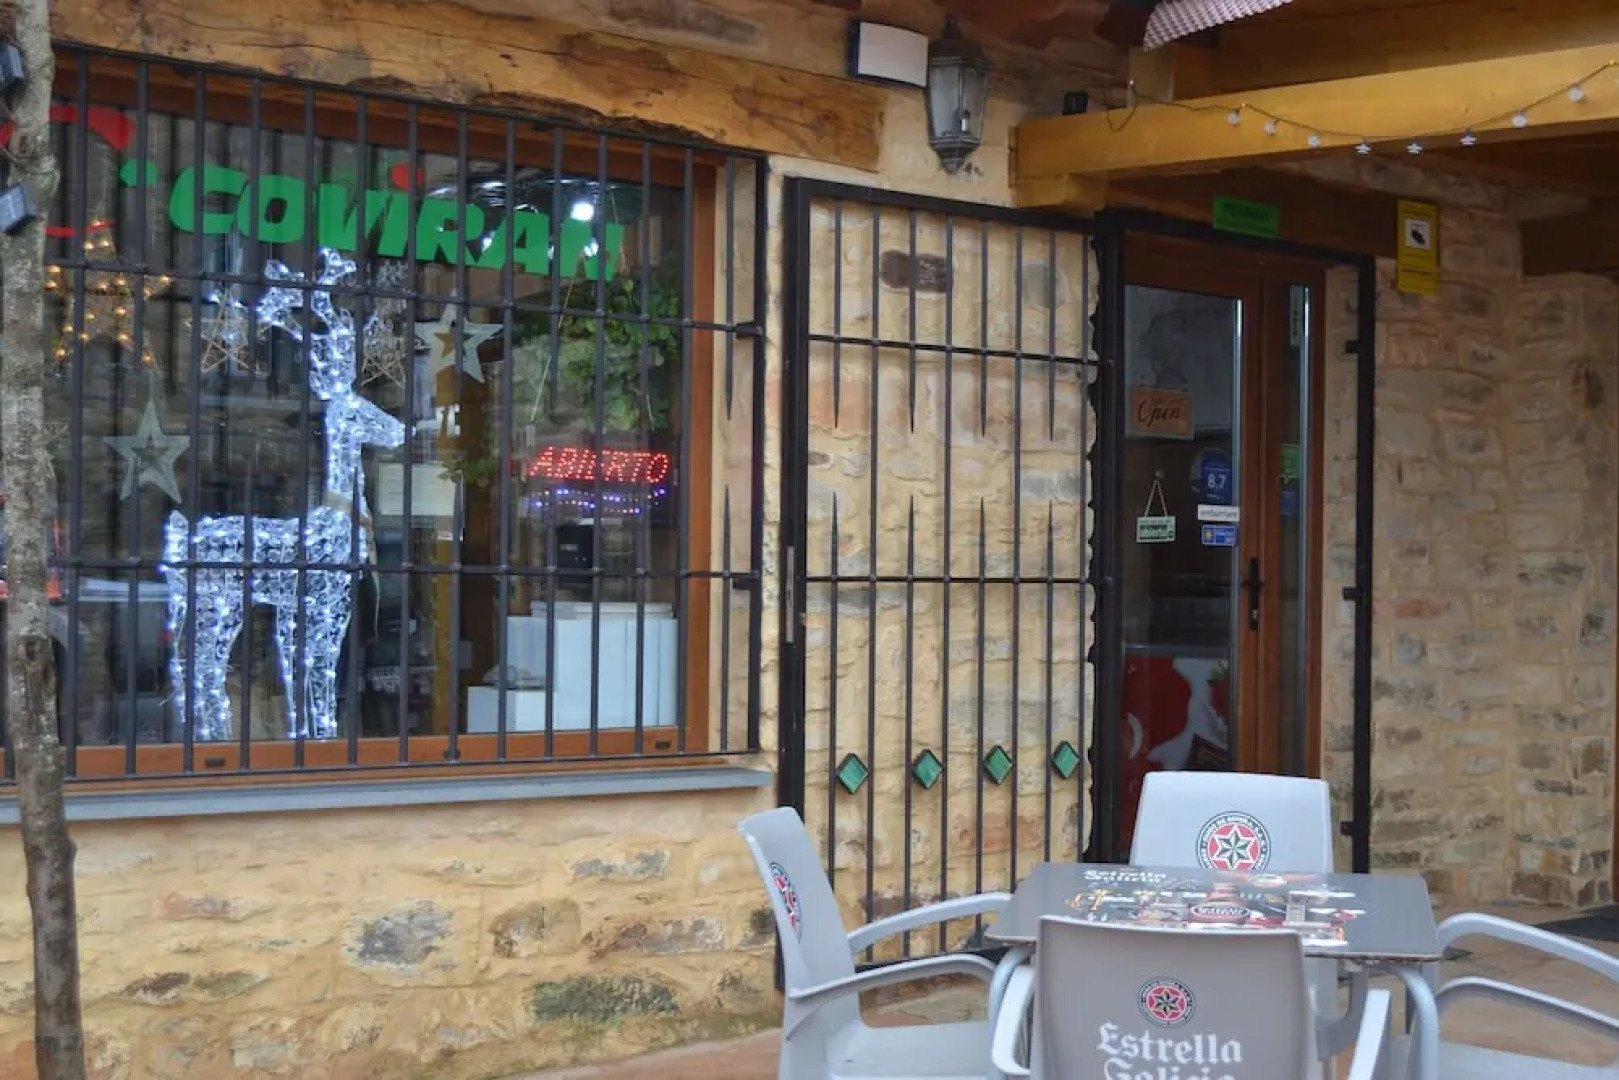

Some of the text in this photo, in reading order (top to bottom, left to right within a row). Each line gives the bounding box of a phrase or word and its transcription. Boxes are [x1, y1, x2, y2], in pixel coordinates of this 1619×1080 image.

[1138, 398, 1181, 428] Open
[529, 446, 669, 484] ABIERTO
[1096, 1021, 1243, 1064] Estrella
